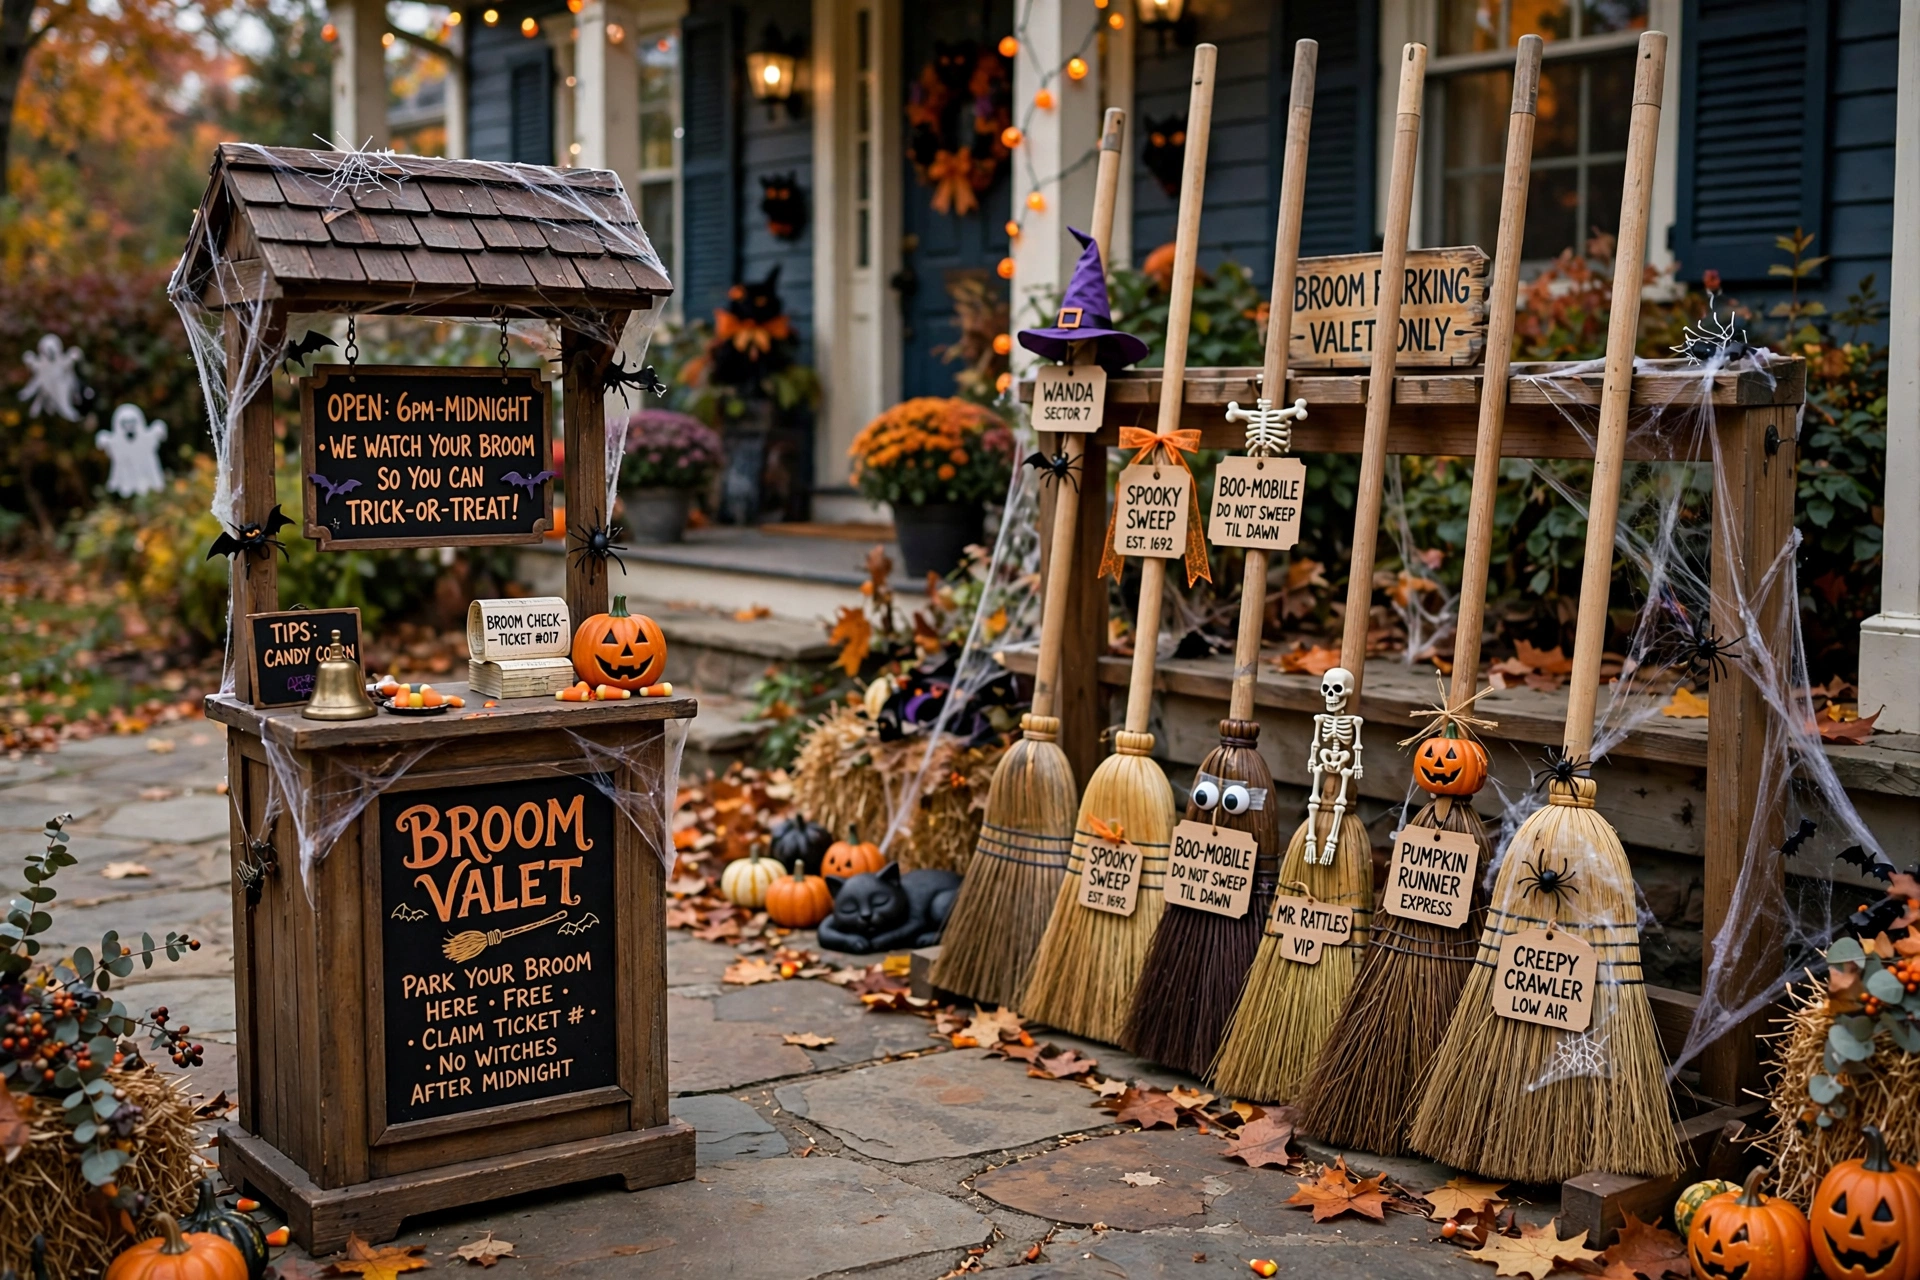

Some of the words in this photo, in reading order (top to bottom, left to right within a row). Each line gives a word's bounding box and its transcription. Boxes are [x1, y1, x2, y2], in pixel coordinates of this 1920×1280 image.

[1294, 272, 1364, 312] BROOM
[1374, 267, 1470, 306] PRKING
[1310, 320, 1376, 354] VALET
[1043, 381, 1094, 403] WANDA
[327, 393, 389, 422] OPEN:
[1044, 407, 1080, 421] SECTOR
[1083, 407, 1091, 420] 7
[329, 434, 357, 459] WE
[364, 434, 422, 458] WATCH
[428, 433, 472, 458] YOUR
[479, 433, 535, 458] BROOM
[377, 465, 400, 491] SO
[408, 465, 441, 490] YOU
[449, 465, 483, 488] CAN
[1219, 476, 1300, 500] BOO-MOBILE
[1126, 485, 1182, 507] SPOOKY
[346, 493, 519, 526] TRICK-OR-TREAT!
[1126, 509, 1176, 531] SWEEP
[1216, 502, 1231, 518] DO
[1234, 504, 1257, 519] NOT
[1258, 505, 1296, 522] SWEEP
[1126, 535, 1146, 549] EST.
[1150, 536, 1173, 551] 1692
[1225, 522, 1242, 538] TIL
[1246, 523, 1279, 540] DAWN
[270, 621, 318, 644] TIPS:
[486, 614, 523, 630] BROOM
[535, 631, 559, 644] #017
[264, 646, 311, 668] CANDY
[395, 794, 594, 869] BROOM
[1089, 846, 1137, 873] SPOOKY
[1174, 836, 1252, 871] BOO-MOBILE
[1400, 842, 1469, 874] PUMPKIN
[413, 856, 583, 922] VALET
[1089, 867, 1131, 891] SWEEP
[1171, 862, 1186, 878] DO
[1188, 867, 1210, 884] NOT
[1211, 871, 1247, 892] SWEEP
[1398, 866, 1461, 898] RUNNER
[1087, 890, 1104, 905] EST.
[1180, 883, 1196, 901] TIL
[1200, 889, 1232, 909] DAWN
[1400, 893, 1453, 917] EXPRESS
[1300, 907, 1349, 934] RATTLES
[1293, 937, 1315, 957] VIP
[1513, 945, 1580, 976] CREEPY
[402, 972, 456, 1000] PARK
[464, 963, 515, 989] YOUR
[524, 951, 592, 981] BROOM
[1504, 968, 1583, 1002] CRAWLER
[425, 995, 479, 1022] HERE
[503, 984, 553, 1011] FREE
[1512, 996, 1541, 1015] LOW
[1544, 1002, 1568, 1022] AIR
[422, 1022, 484, 1050] CLAIM
[493, 1009, 562, 1038] TICKET
[439, 1052, 466, 1076] NO
[474, 1036, 558, 1068] WITCHES
[410, 1077, 473, 1106] AFTER
[482, 1058, 574, 1093] MIDNIGHT
